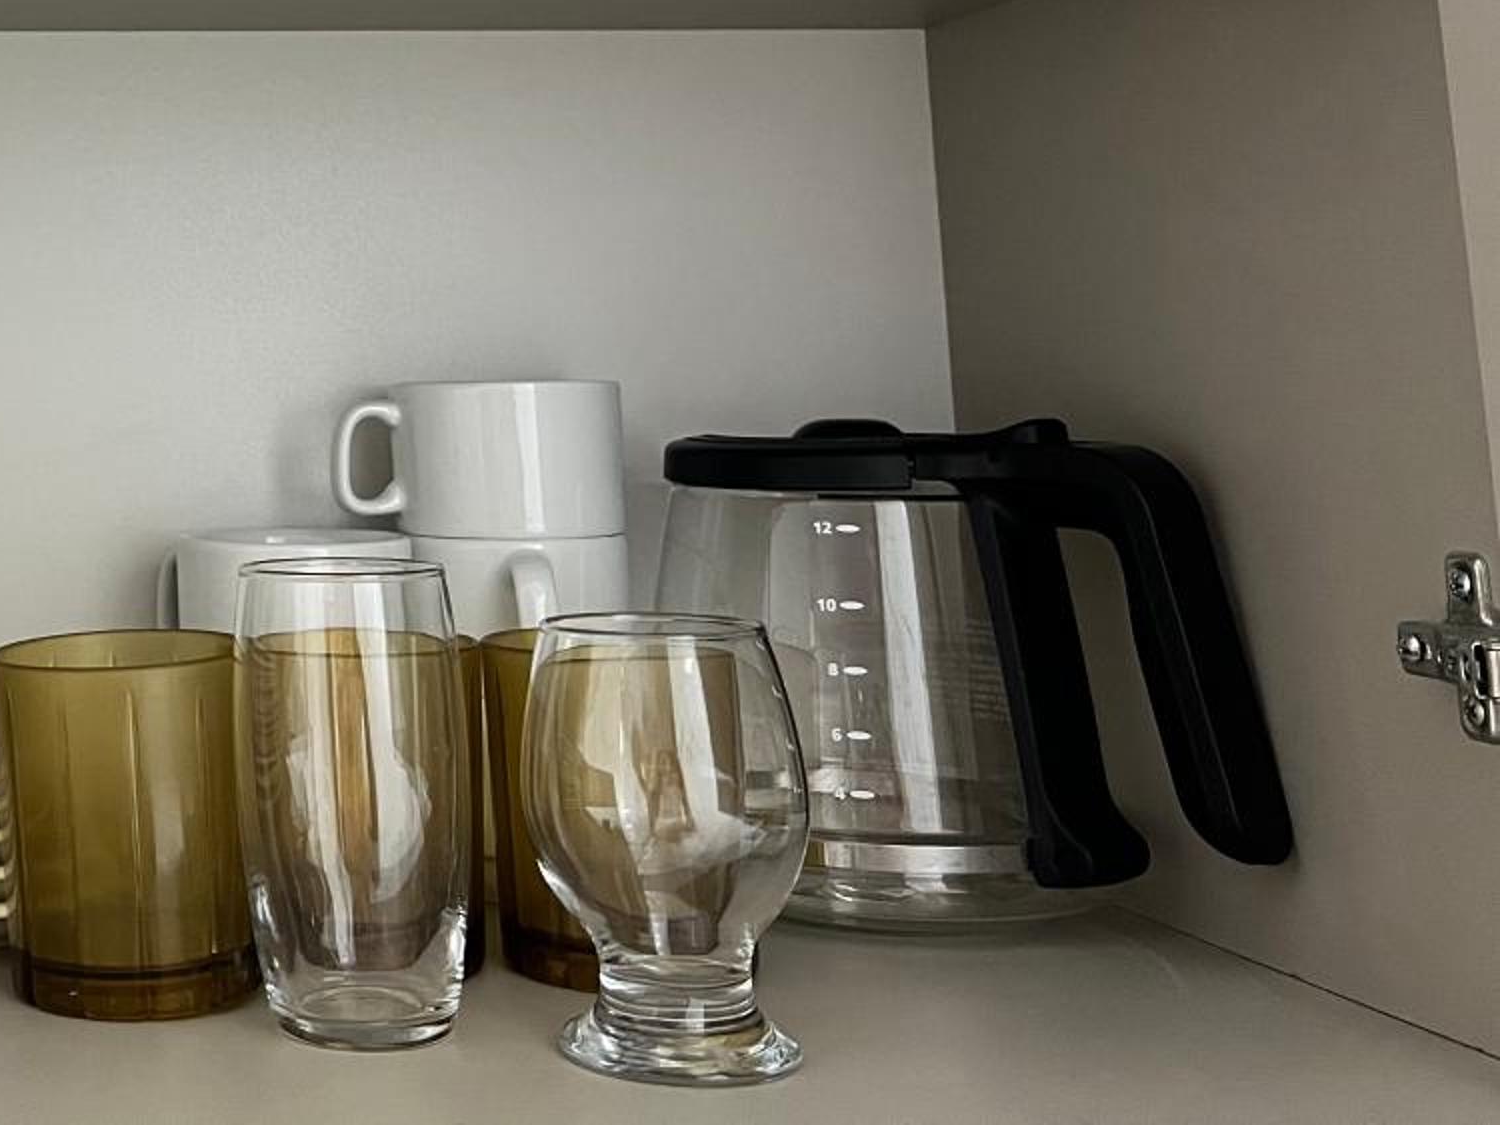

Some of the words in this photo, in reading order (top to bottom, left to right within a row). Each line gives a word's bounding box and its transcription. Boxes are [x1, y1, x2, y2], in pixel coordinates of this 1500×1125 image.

[813, 521, 833, 535] 12
[816, 598, 837, 612] 10
[827, 662, 839, 676] 8
[831, 728, 843, 742] 6
[834, 786, 847, 800] 4
